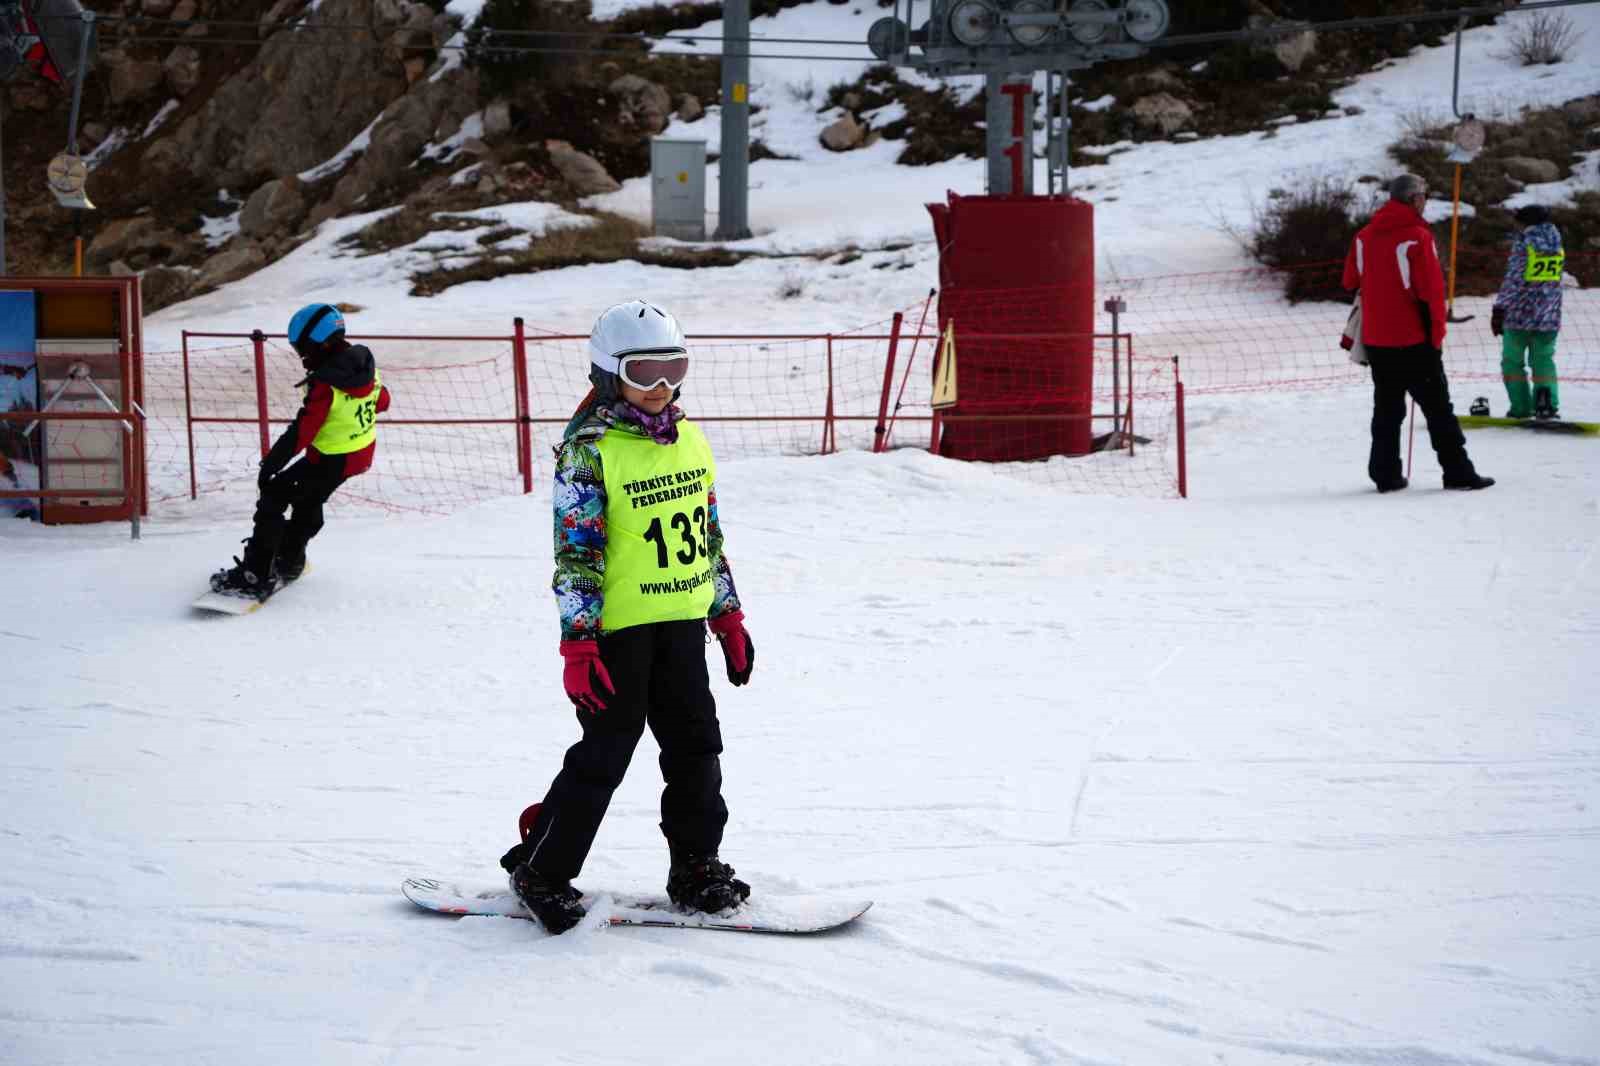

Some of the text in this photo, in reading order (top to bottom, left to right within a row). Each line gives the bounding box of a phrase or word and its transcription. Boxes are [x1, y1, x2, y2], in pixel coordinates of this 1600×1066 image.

[623, 473, 673, 495] TÜRKİYE
[631, 480, 703, 508] FEDERASYONU
[643, 506, 707, 568] 133
